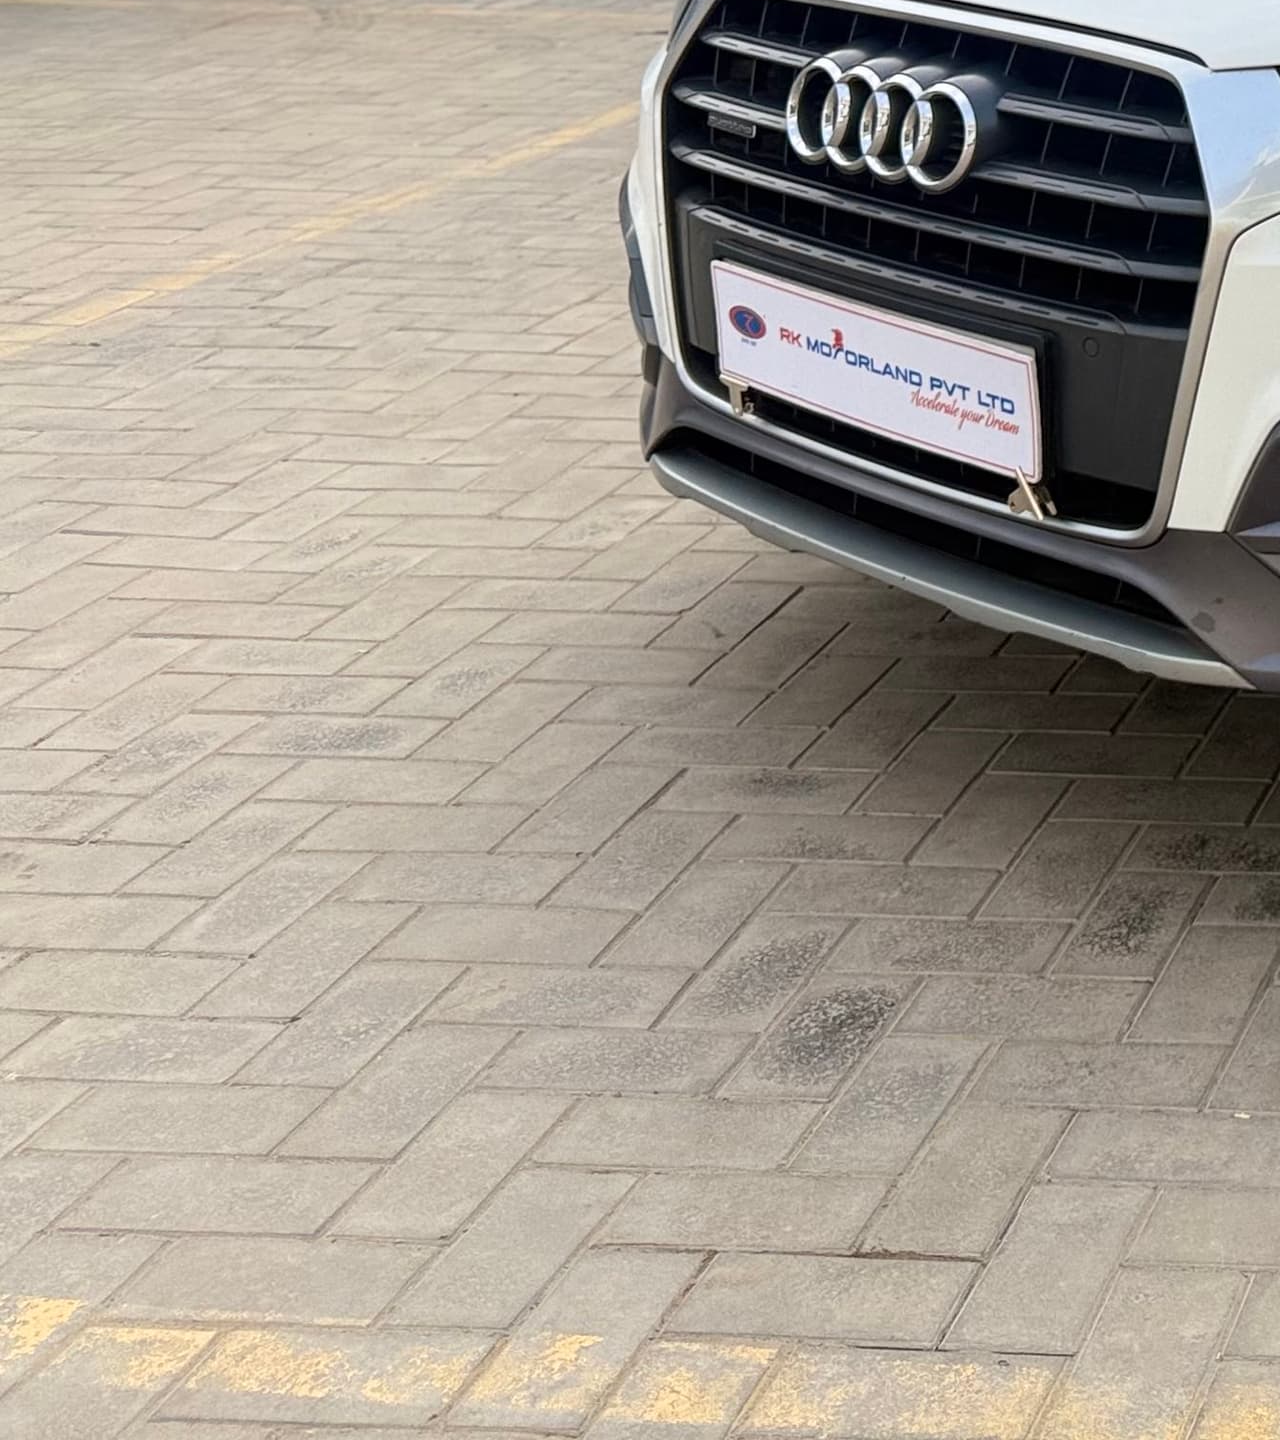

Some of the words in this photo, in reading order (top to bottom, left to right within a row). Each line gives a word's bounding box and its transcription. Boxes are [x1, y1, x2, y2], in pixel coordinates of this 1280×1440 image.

[779, 327, 802, 348] RK
[930, 376, 970, 401] PVT
[977, 390, 1015, 415] LTD
[911, 388, 960, 418] Accelerate
[960, 407, 985, 431] your
[985, 409, 1020, 436] Dream
